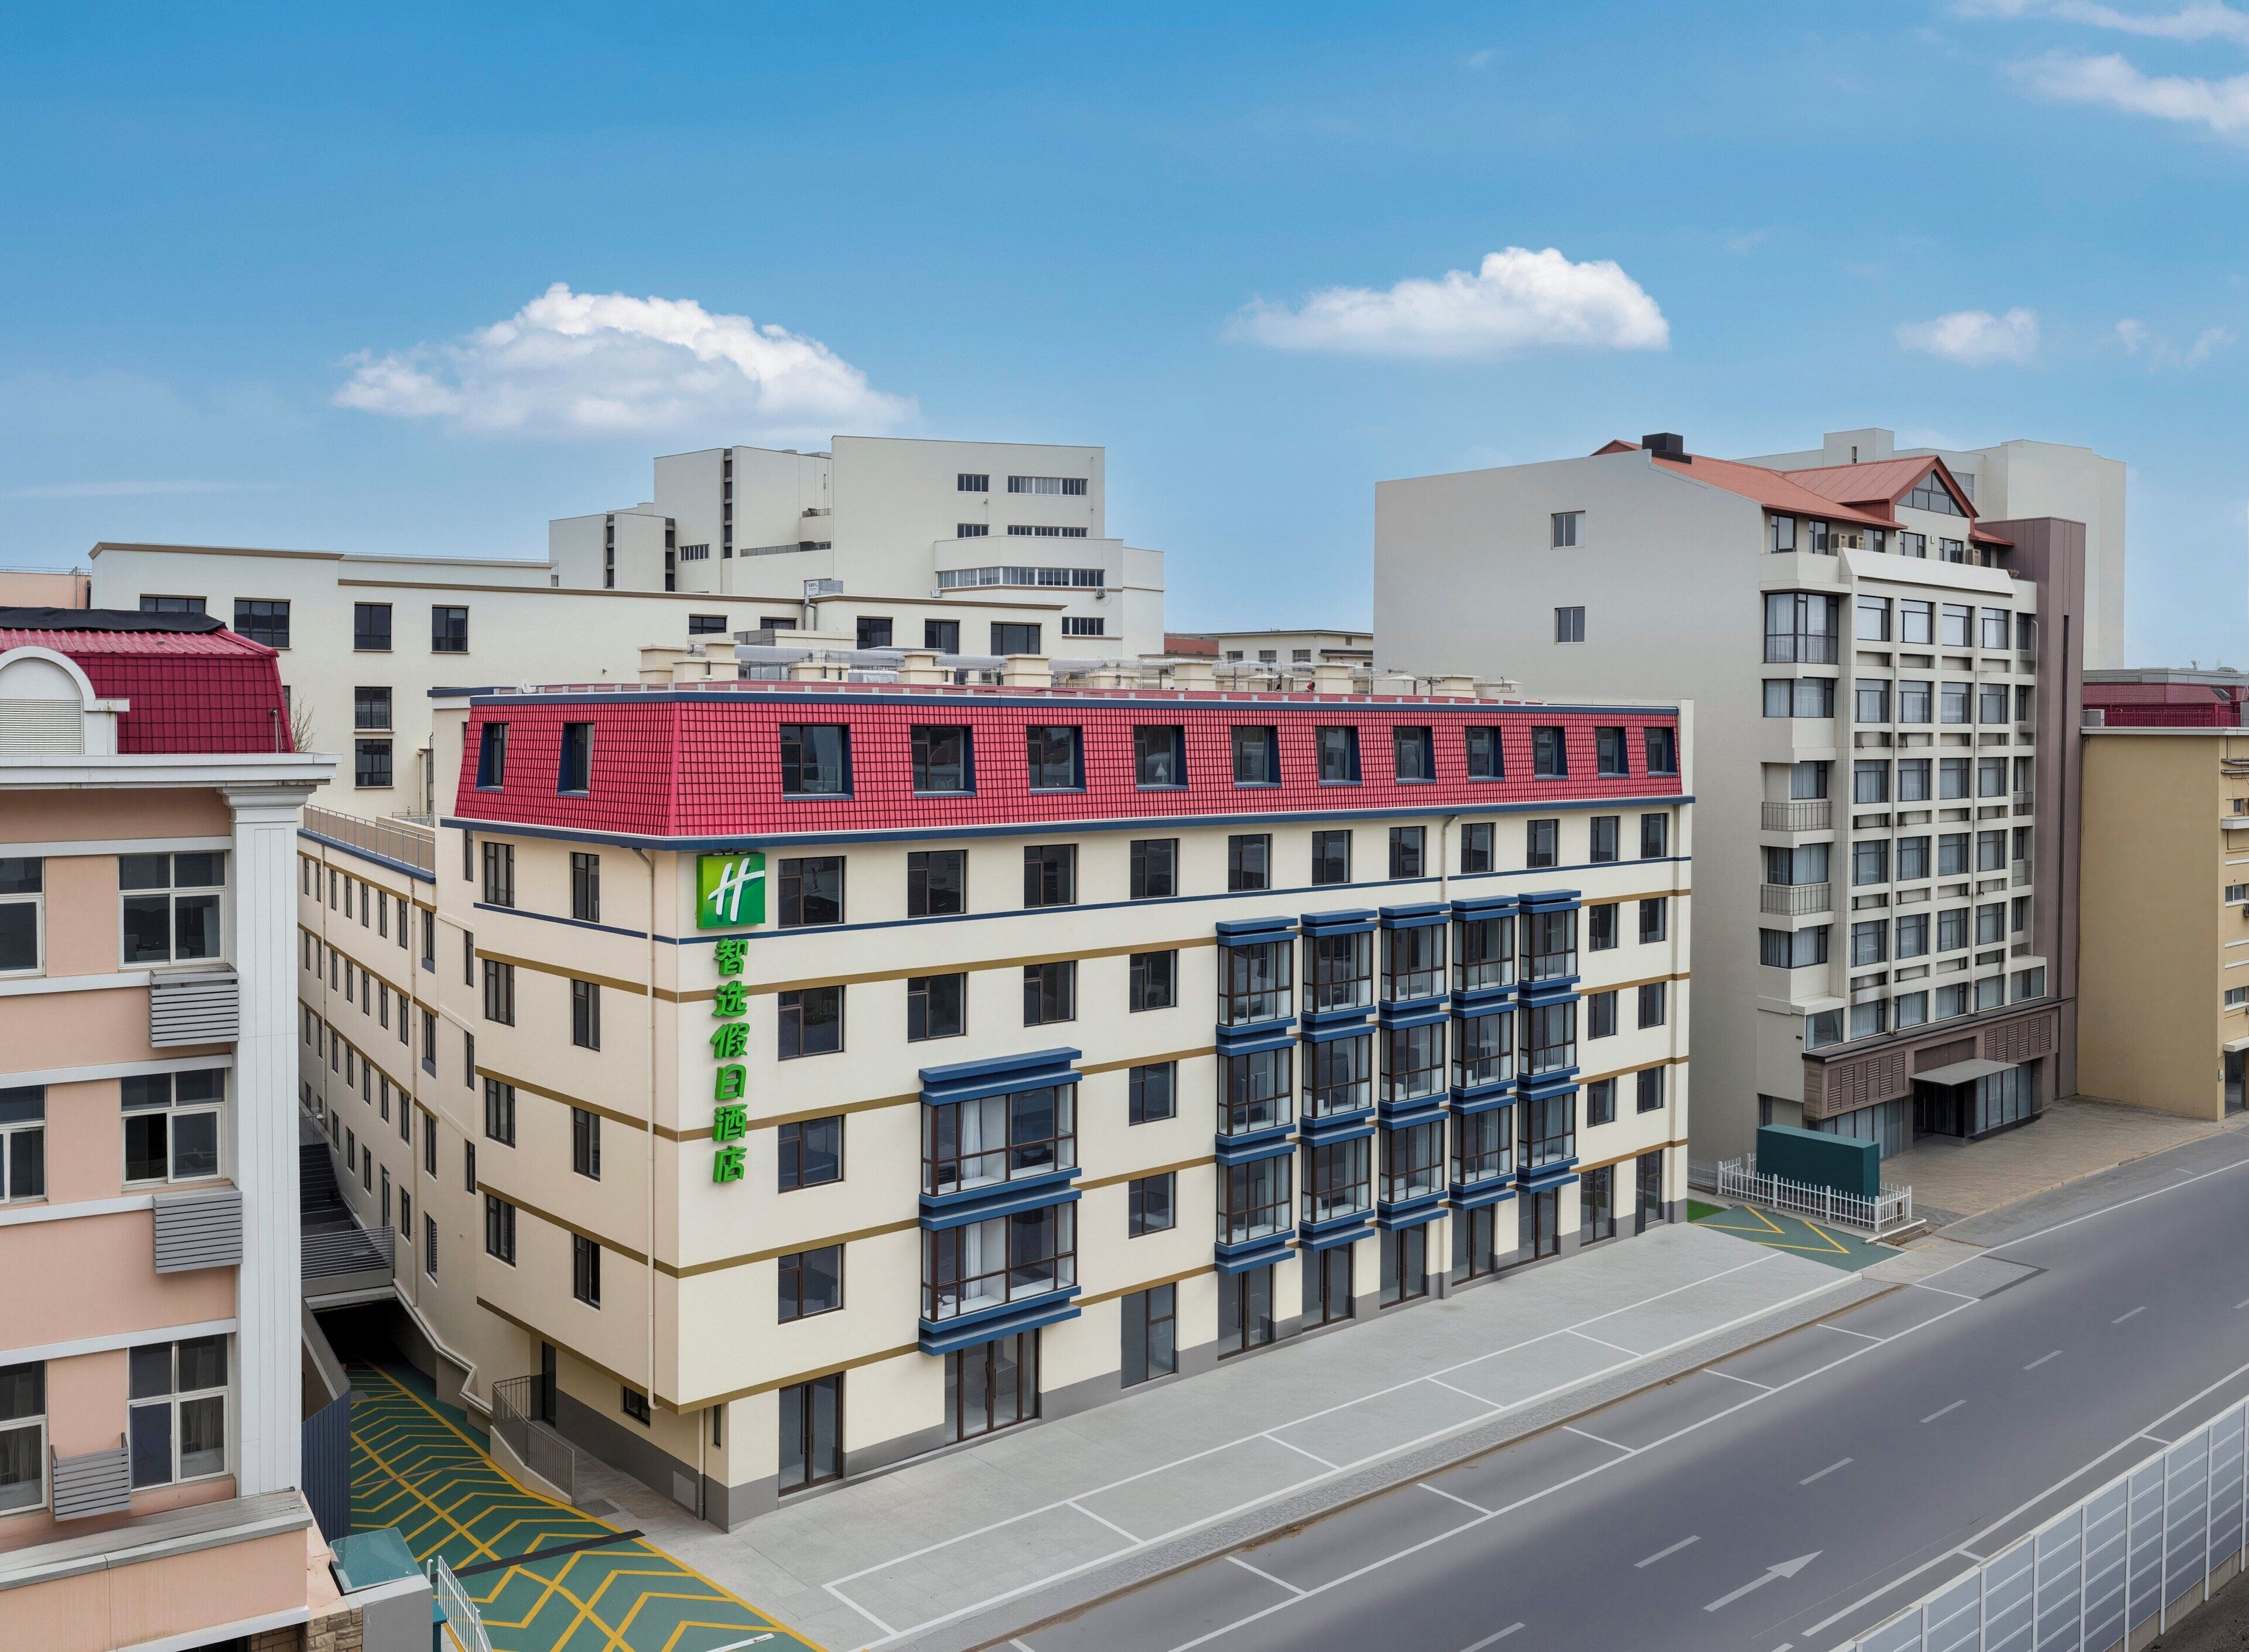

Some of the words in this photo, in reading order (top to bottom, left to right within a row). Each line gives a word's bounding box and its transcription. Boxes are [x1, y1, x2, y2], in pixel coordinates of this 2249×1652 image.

[708, 857, 765, 922] H
[709, 937, 750, 1184] 智选假日酒店
